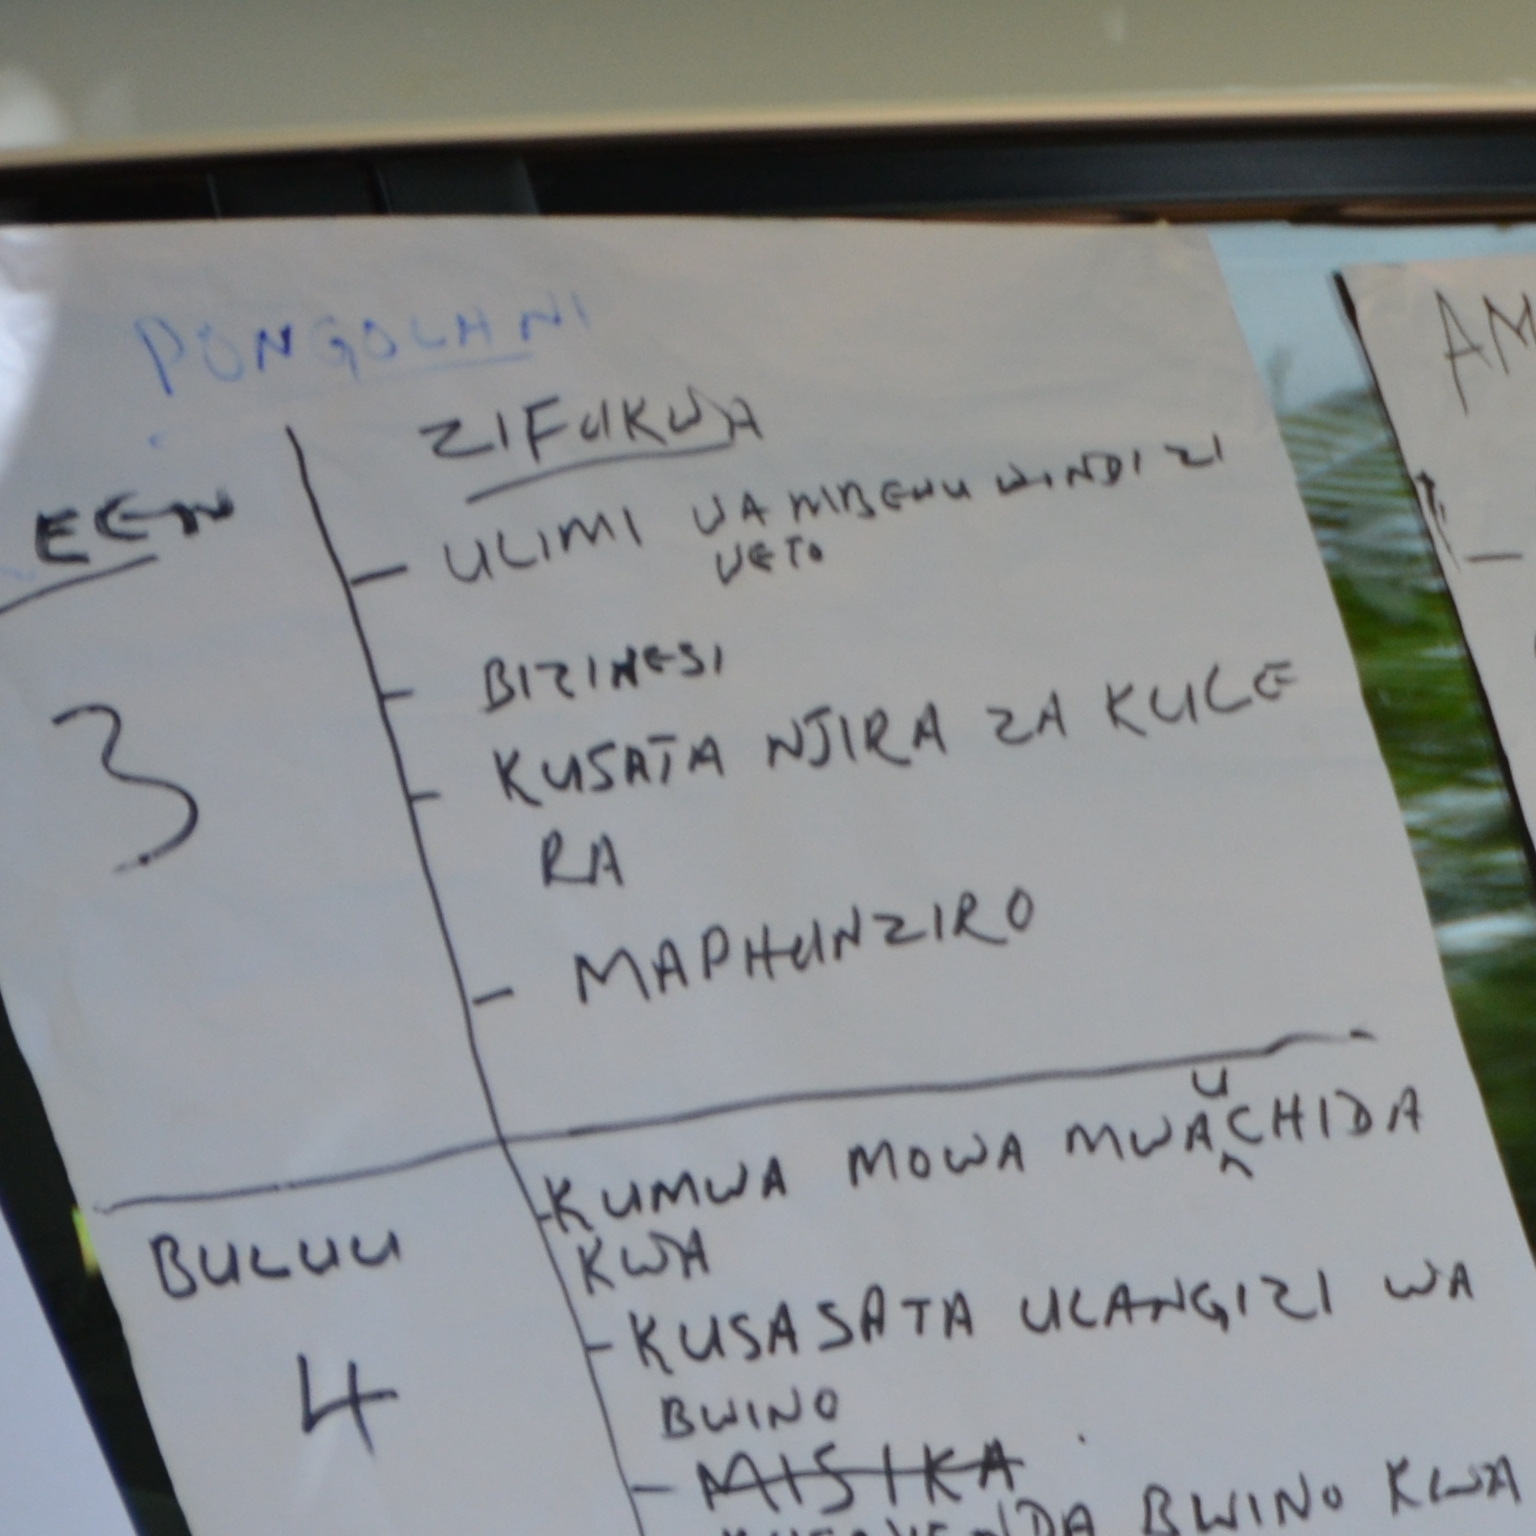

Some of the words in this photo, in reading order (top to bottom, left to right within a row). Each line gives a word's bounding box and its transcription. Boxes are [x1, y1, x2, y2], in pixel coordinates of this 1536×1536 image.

[443, 506, 642, 585] ULIMI
[51, 700, 200, 875] 3
[494, 733, 727, 808] KUSATA
[766, 700, 948, 768] NJIRA
[540, 828, 626, 888] RA
[543, 1155, 788, 1235] KUMWA
[847, 1130, 1025, 1190] MOWA
[148, 1228, 402, 1300] BULUU
[577, 1226, 711, 1296] KWA
[629, 1282, 976, 1377] KUSASATA
[1383, 1258, 1475, 1302] WA
[296, 1353, 398, 1458] 4
[661, 1386, 839, 1441] BWINO
[1385, 1452, 1522, 1518] KWA
